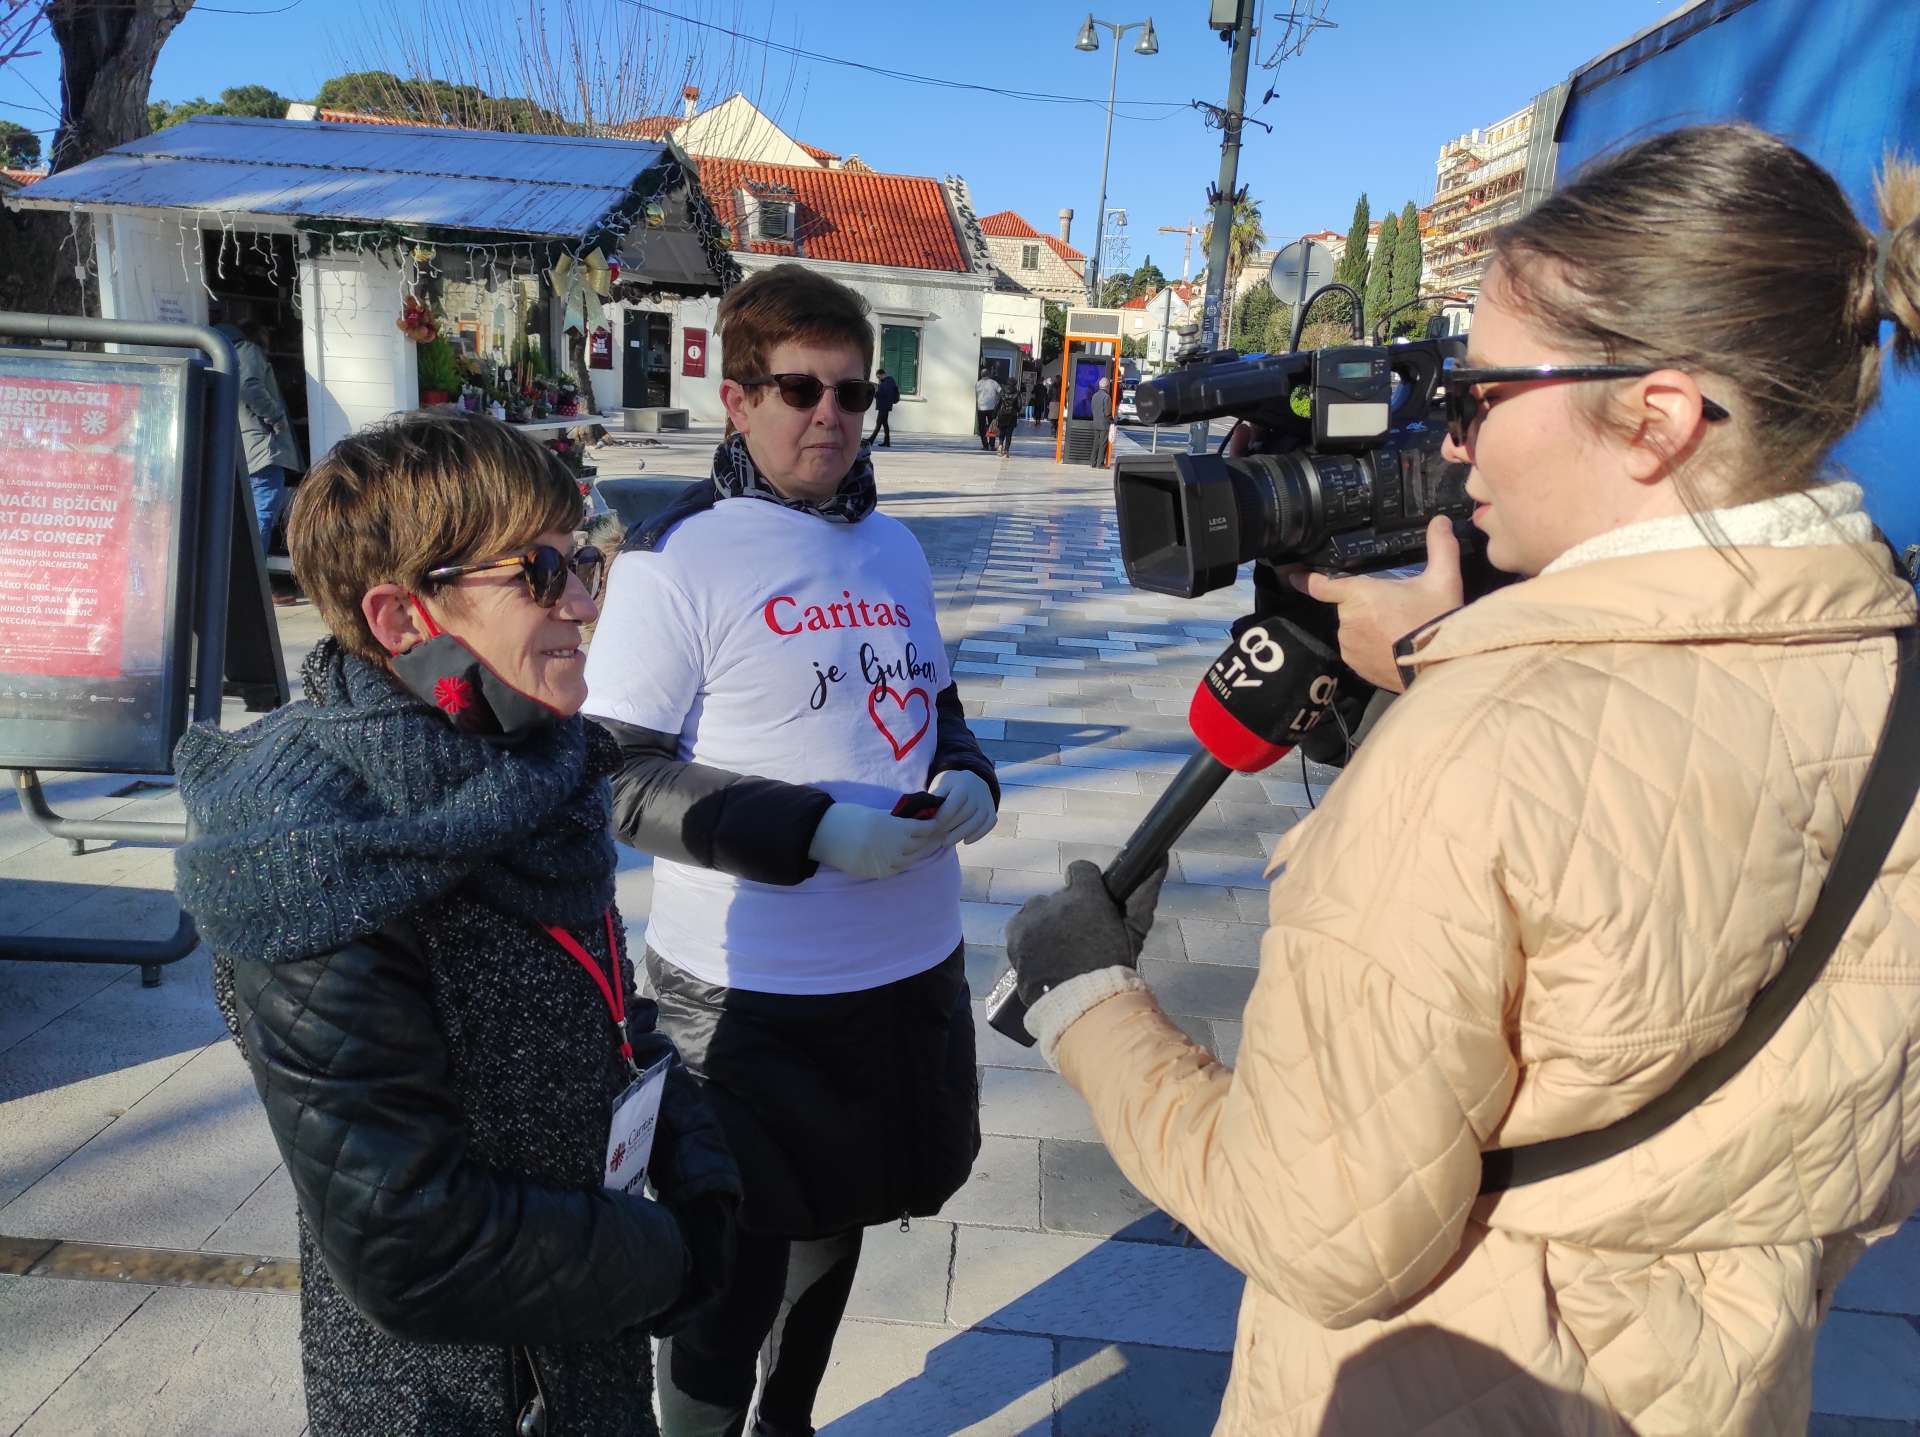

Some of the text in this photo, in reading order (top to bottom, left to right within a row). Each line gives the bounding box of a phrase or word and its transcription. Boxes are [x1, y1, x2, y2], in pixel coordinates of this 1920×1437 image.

[20, 513, 114, 529] DUBROVNIK
[33, 530, 104, 546] CONCERT
[764, 590, 911, 636] Caritas
[810, 661, 847, 710] je
